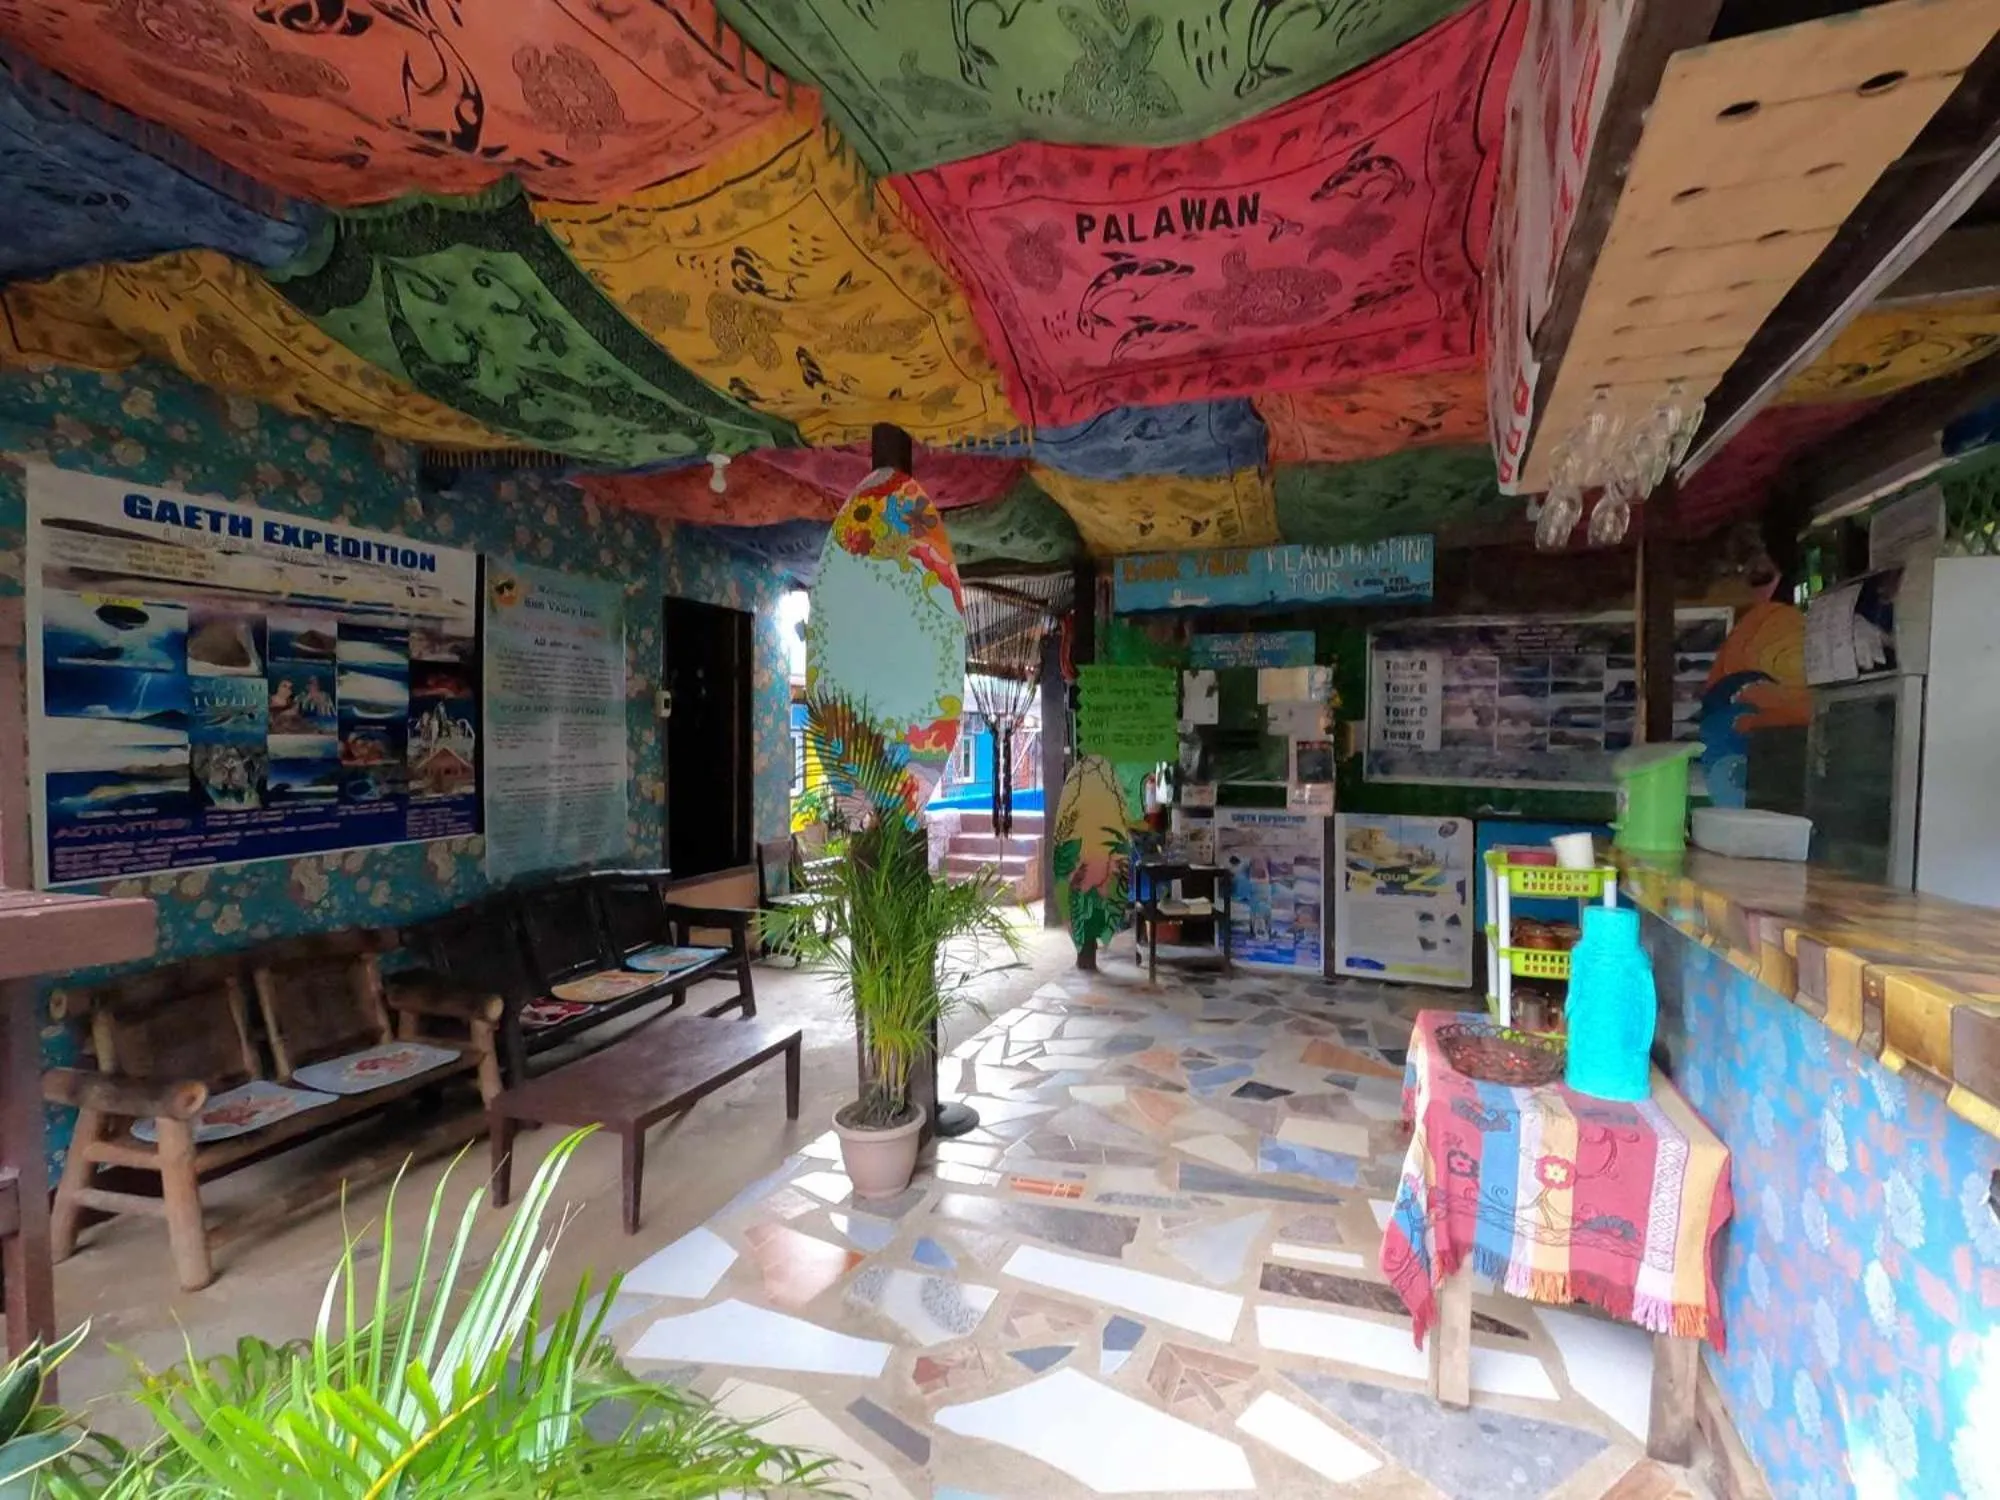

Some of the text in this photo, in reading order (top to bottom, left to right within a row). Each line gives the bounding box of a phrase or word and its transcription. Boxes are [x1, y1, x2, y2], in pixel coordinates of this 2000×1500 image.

[1075, 191, 1261, 244] PALAWAN
[123, 493, 253, 539] GAETH
[262, 520, 437, 573] EXPEDITION
[1384, 659, 1416, 671] Tour
[1384, 682, 1416, 694] Tour
[1384, 706, 1416, 718] Tour
[1382, 729, 1413, 741] Tour
[1376, 873, 1410, 882] TOUR
